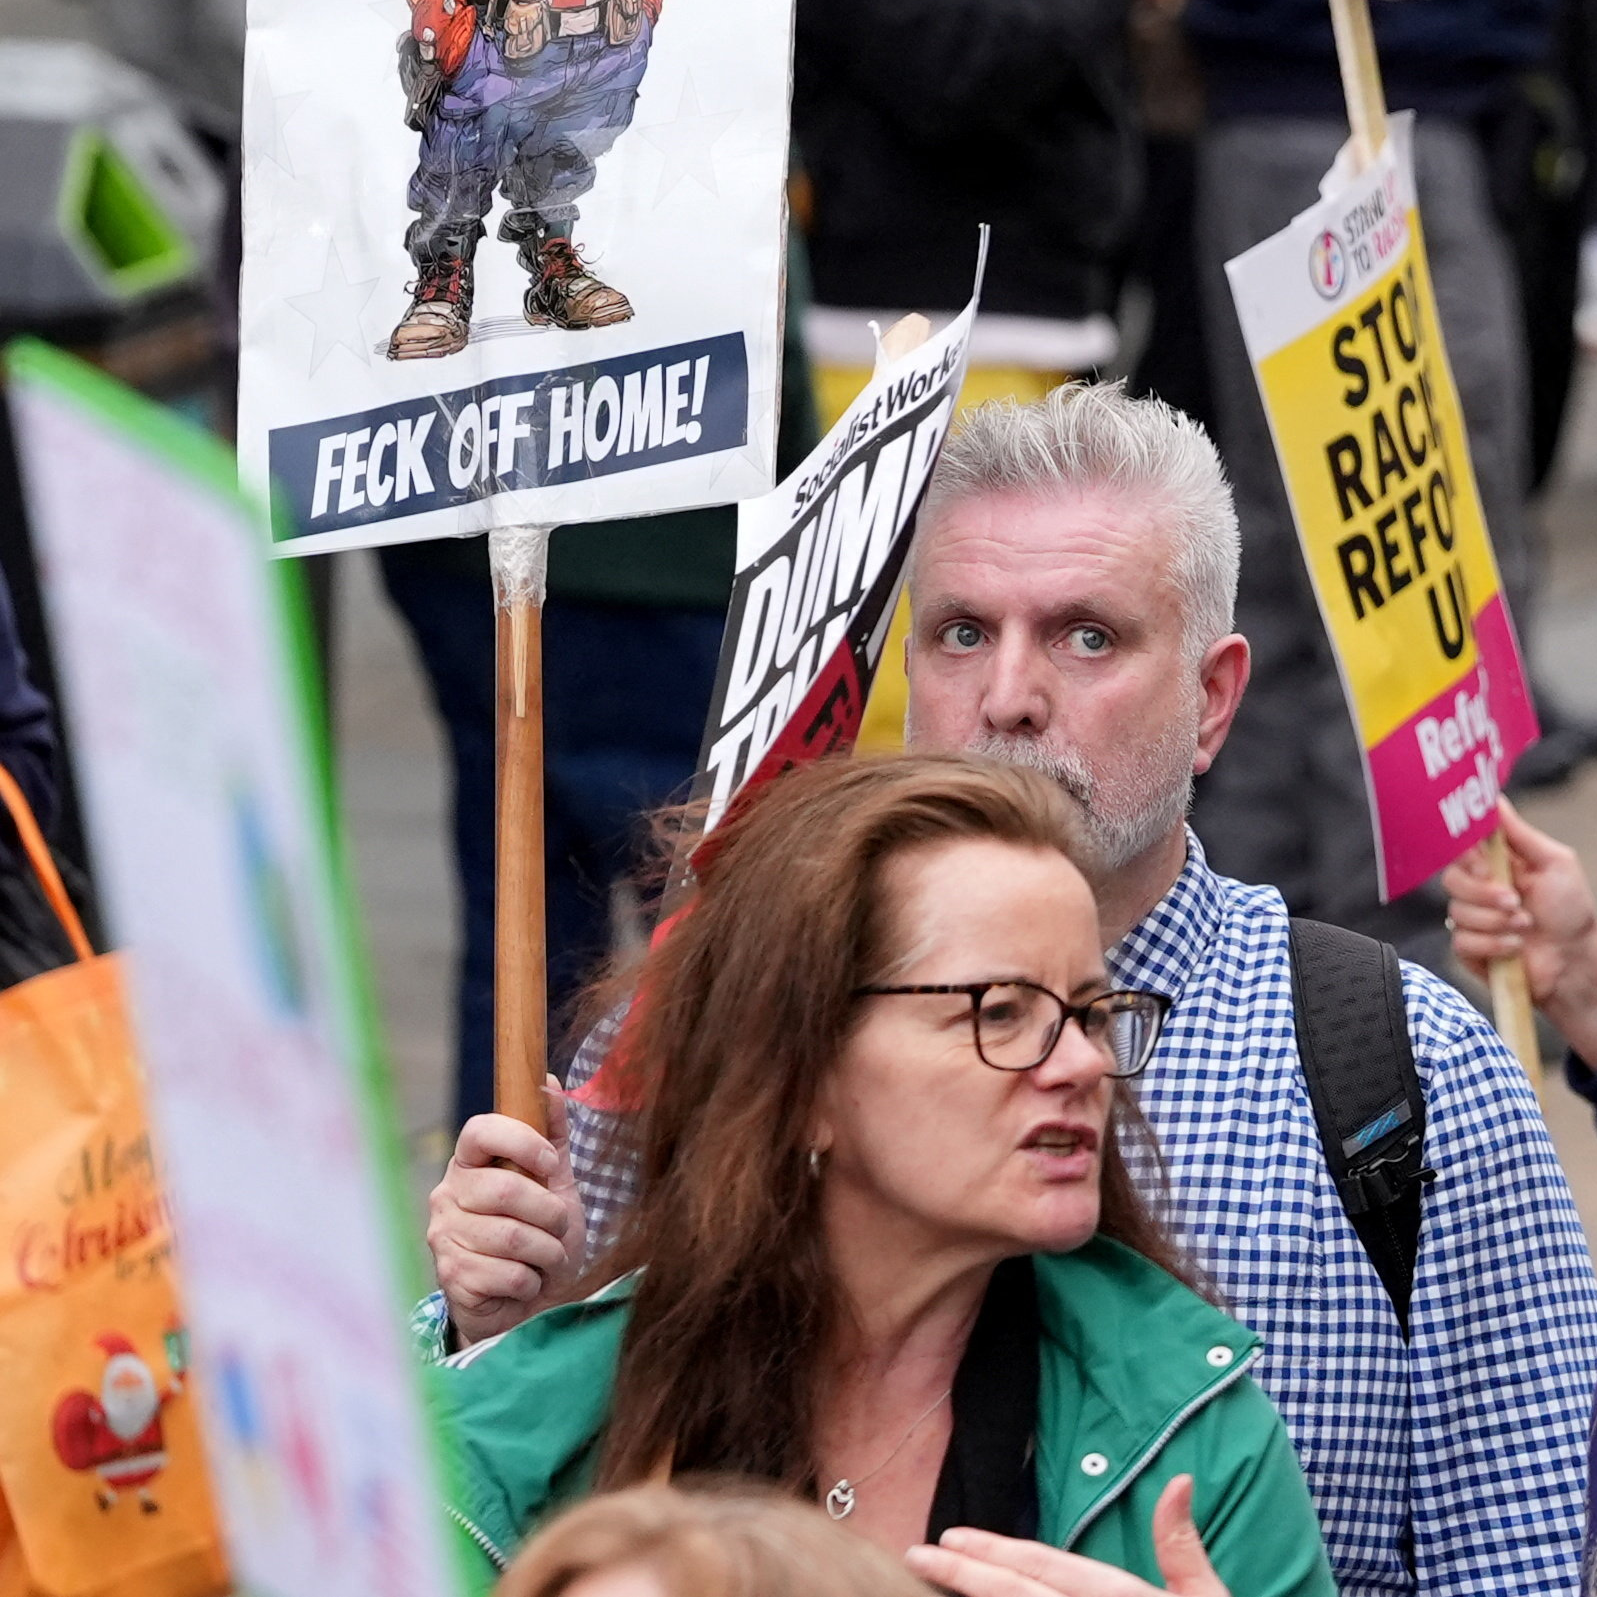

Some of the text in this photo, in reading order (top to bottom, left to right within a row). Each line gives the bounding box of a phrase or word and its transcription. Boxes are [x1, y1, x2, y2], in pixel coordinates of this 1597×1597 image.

[1331, 269, 1421, 407] STO
[310, 354, 711, 520] FECK OFF HOME!
[791, 334, 966, 520] Socialist Worke
[1335, 470, 1455, 621] REFO
